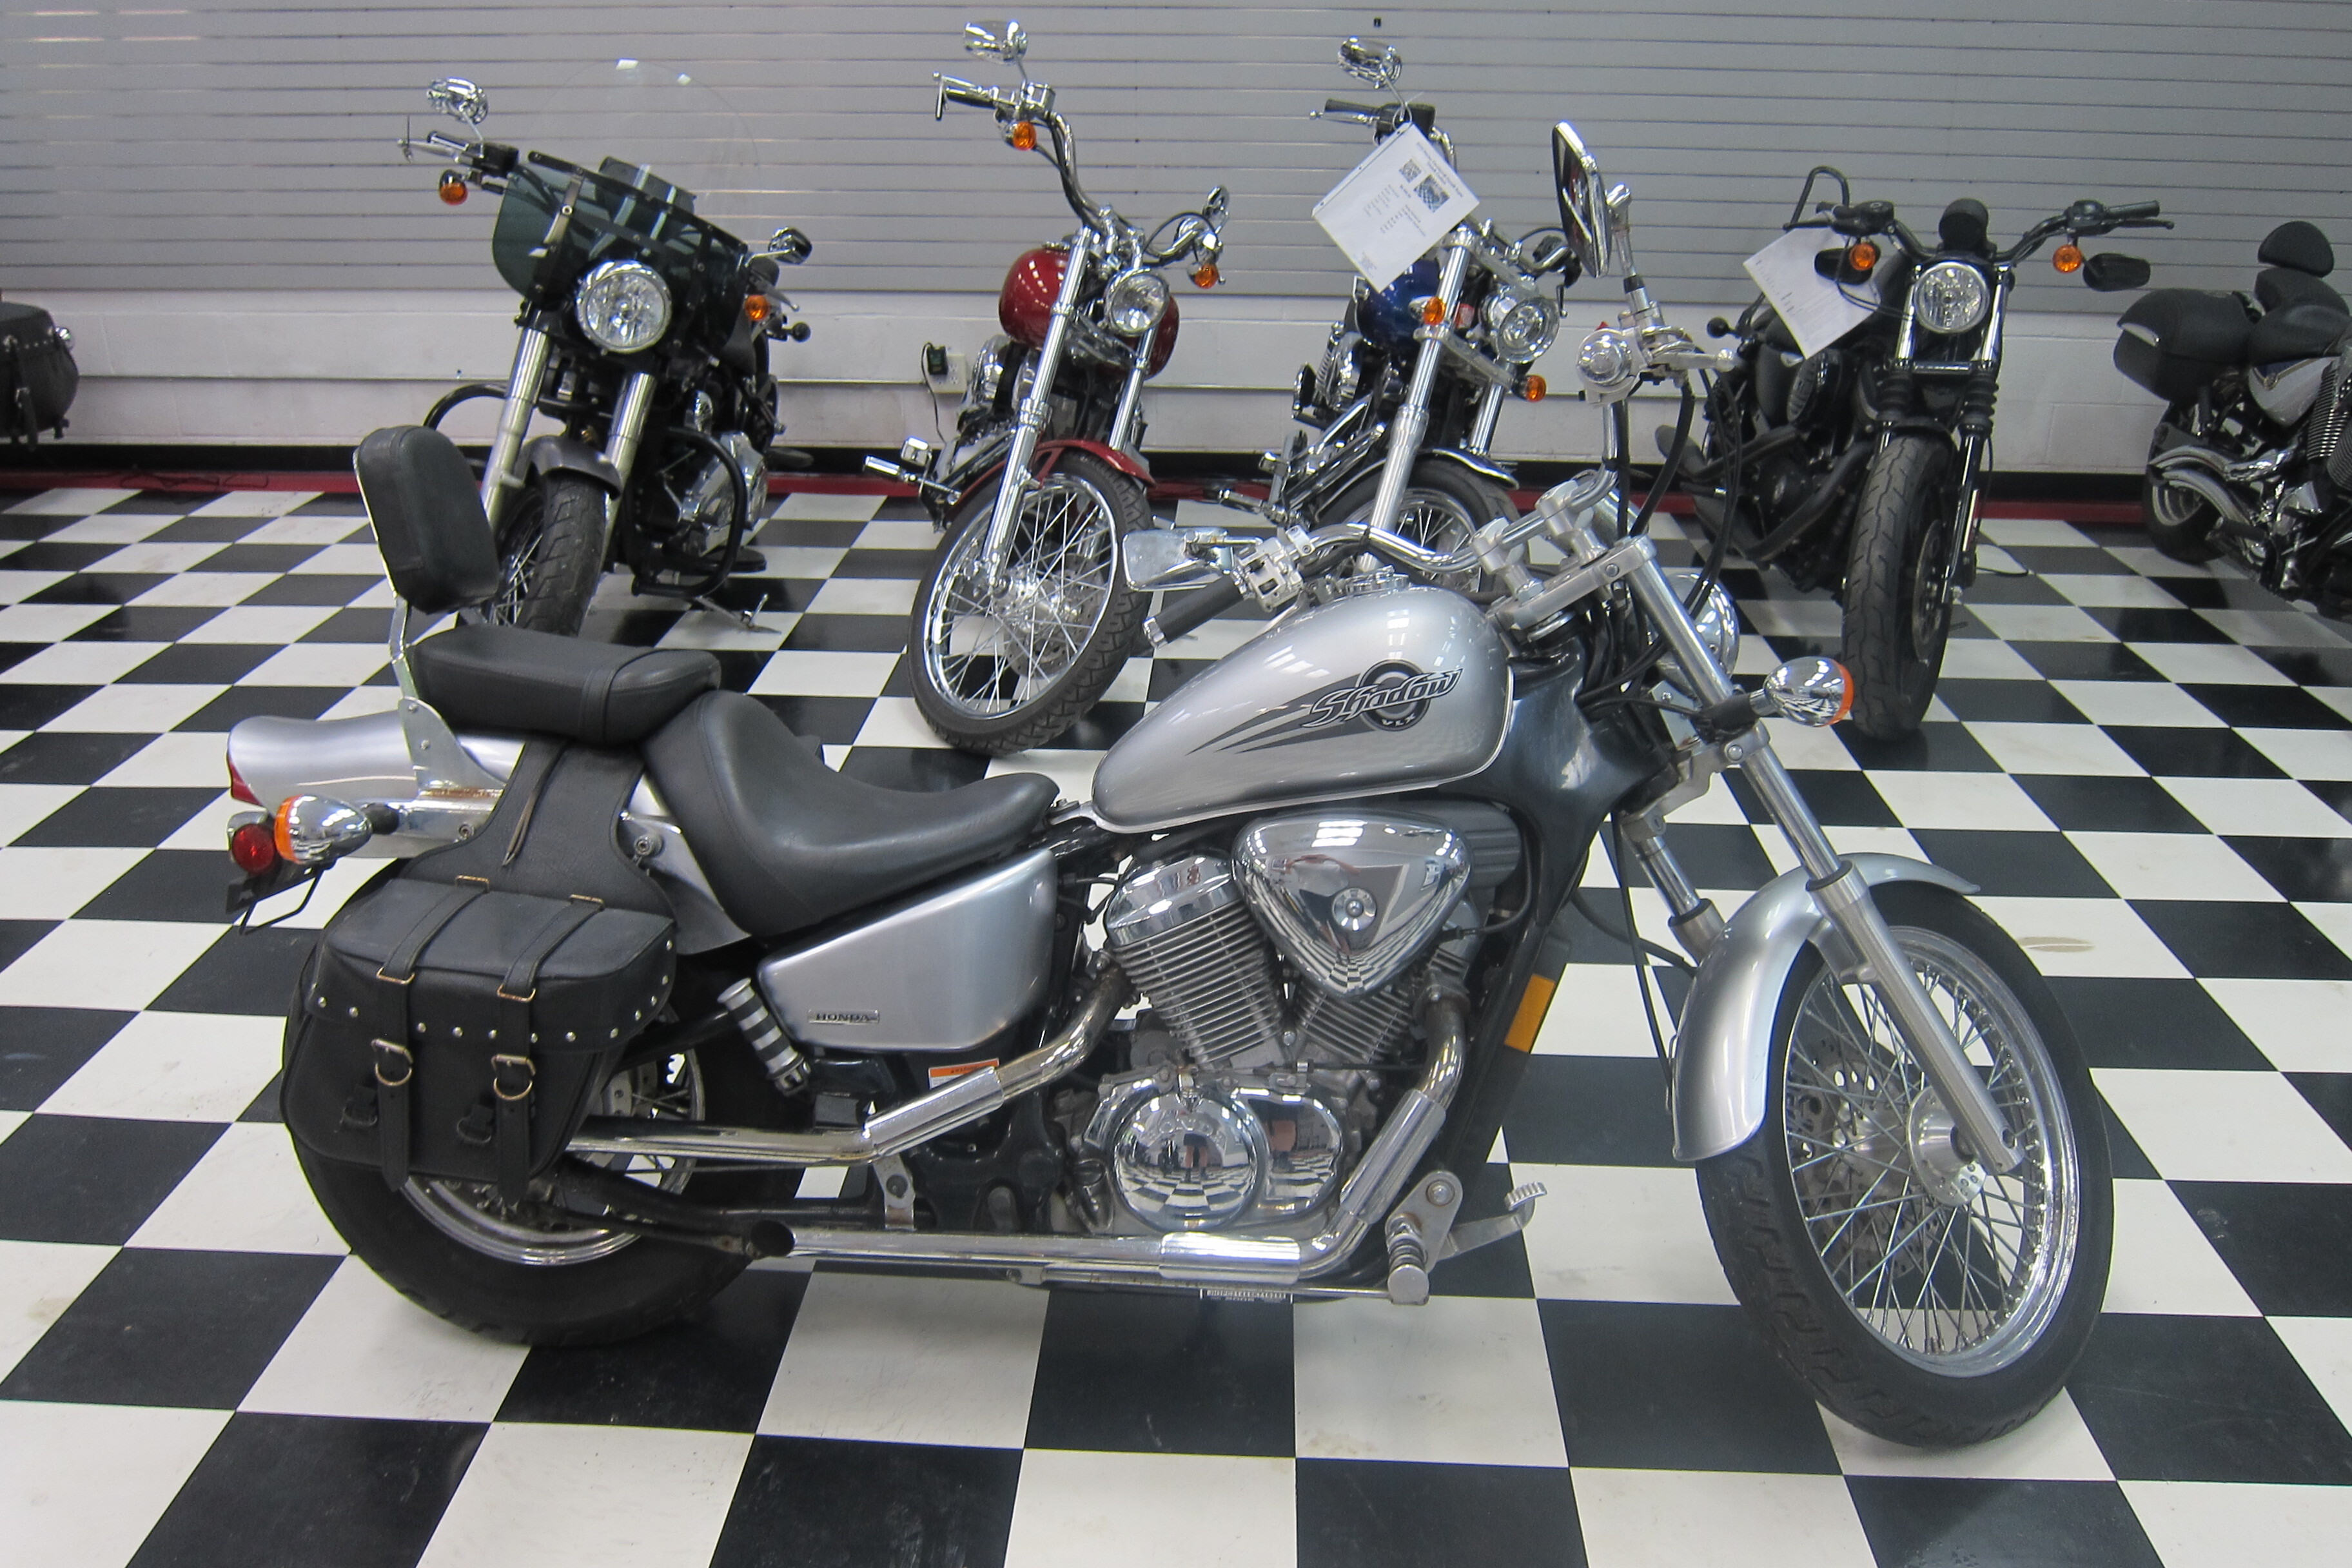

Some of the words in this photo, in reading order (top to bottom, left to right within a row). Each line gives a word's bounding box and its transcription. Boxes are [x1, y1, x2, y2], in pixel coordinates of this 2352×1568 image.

[1300, 668, 1464, 727] Shadow
[1382, 713, 1416, 727] VLX
[816, 1013, 869, 1023] HONDA
